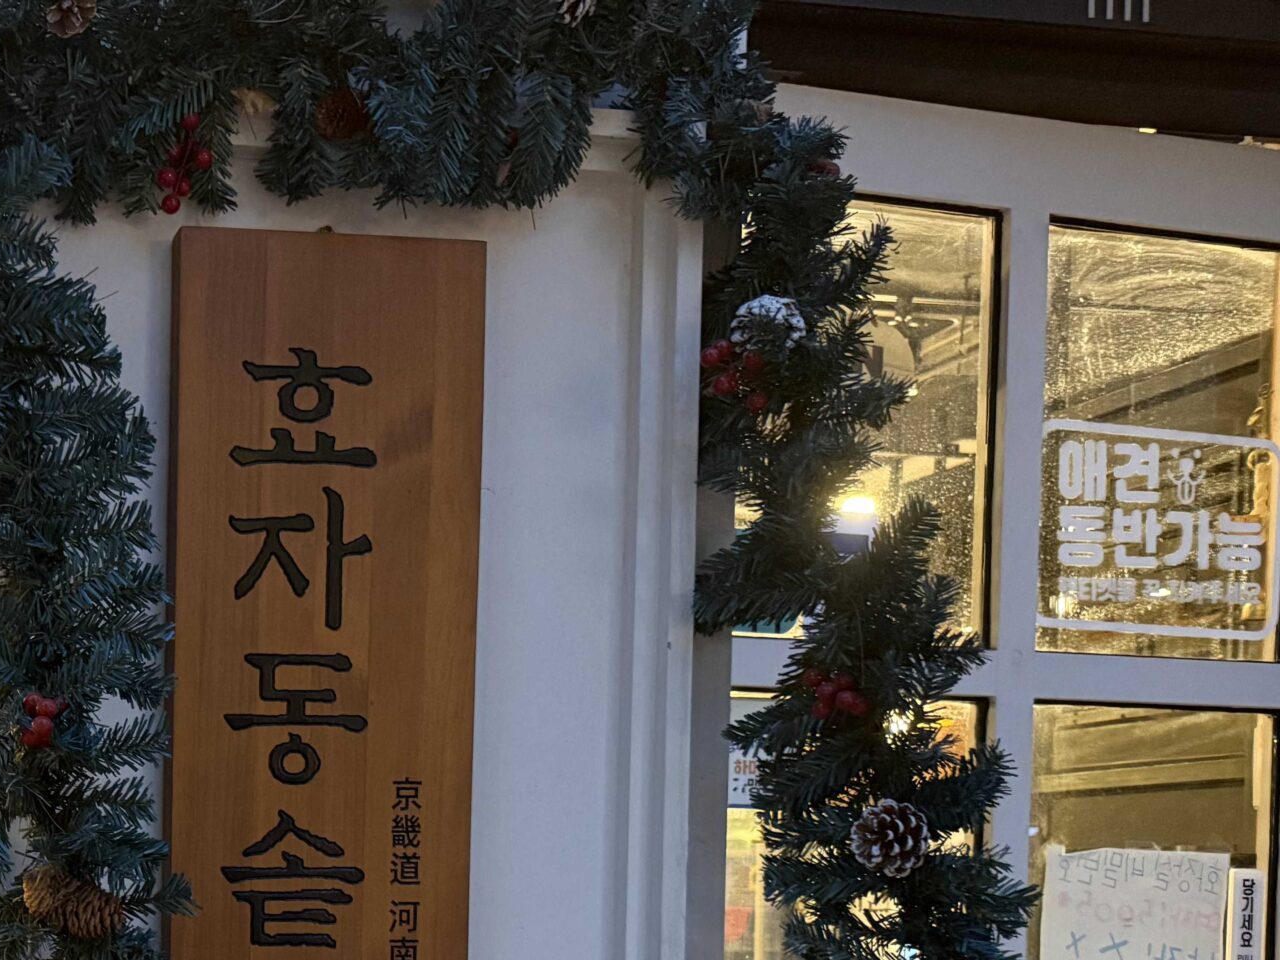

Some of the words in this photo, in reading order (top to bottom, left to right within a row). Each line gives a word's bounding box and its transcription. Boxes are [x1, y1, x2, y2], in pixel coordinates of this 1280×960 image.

[1058, 439, 1160, 503] 애견
[1056, 505, 1265, 571] 동반가능
[389, 777, 423, 886] 京畿道
[1239, 877, 1256, 948] 당기세요
